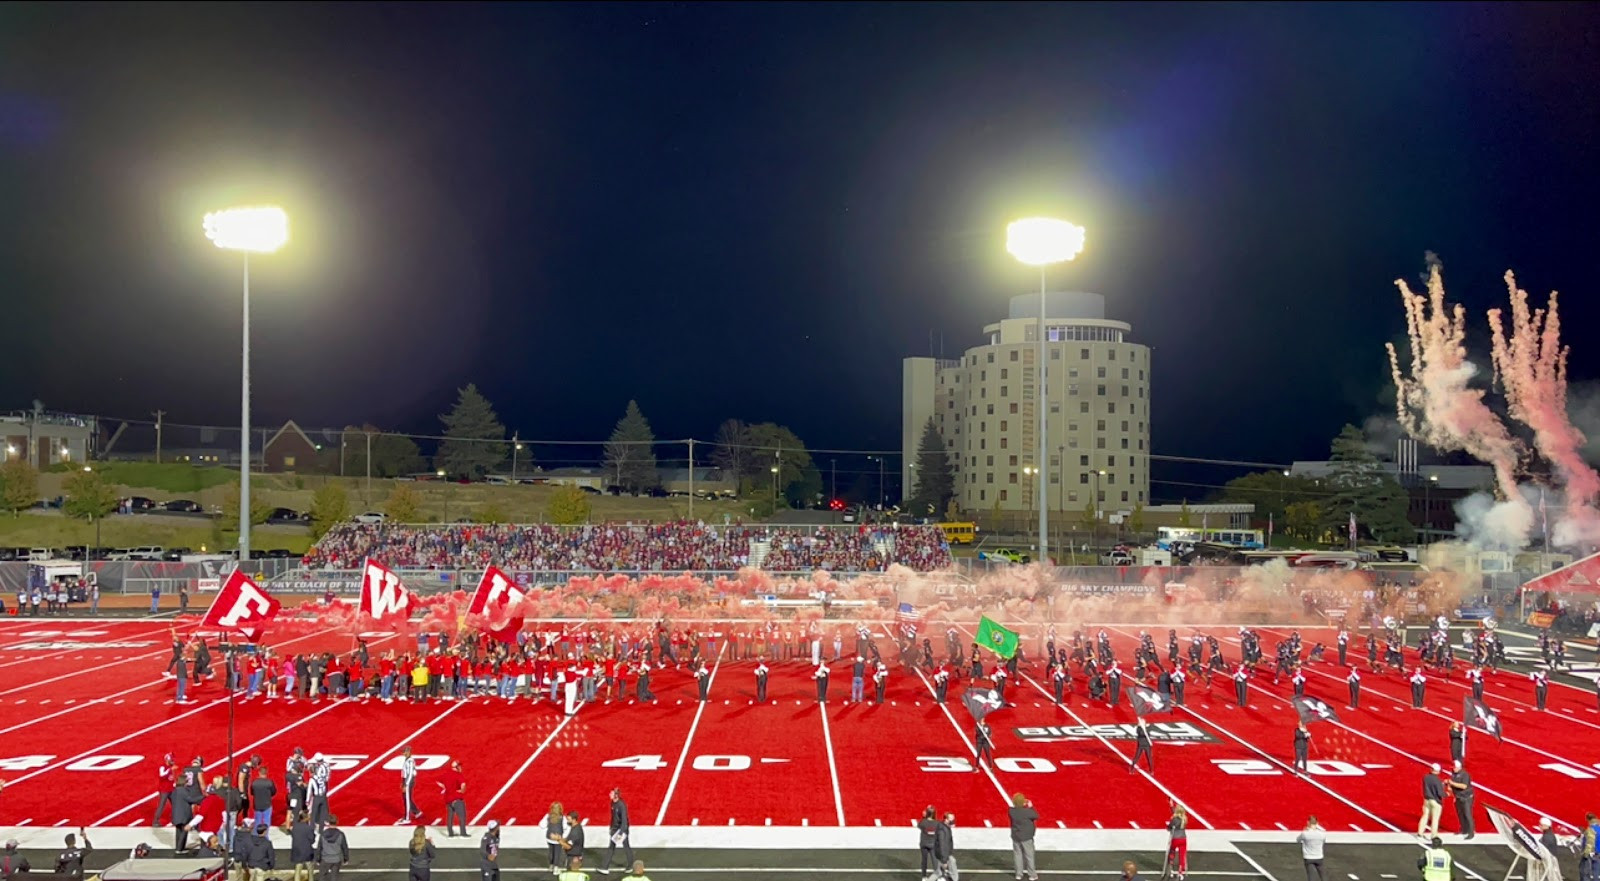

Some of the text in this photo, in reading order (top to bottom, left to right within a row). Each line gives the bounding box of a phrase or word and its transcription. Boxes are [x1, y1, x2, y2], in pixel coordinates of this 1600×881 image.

[368, 564, 409, 620] W
[1080, 584, 1099, 592] SKY
[1101, 585, 1156, 593] CHAMPIONS
